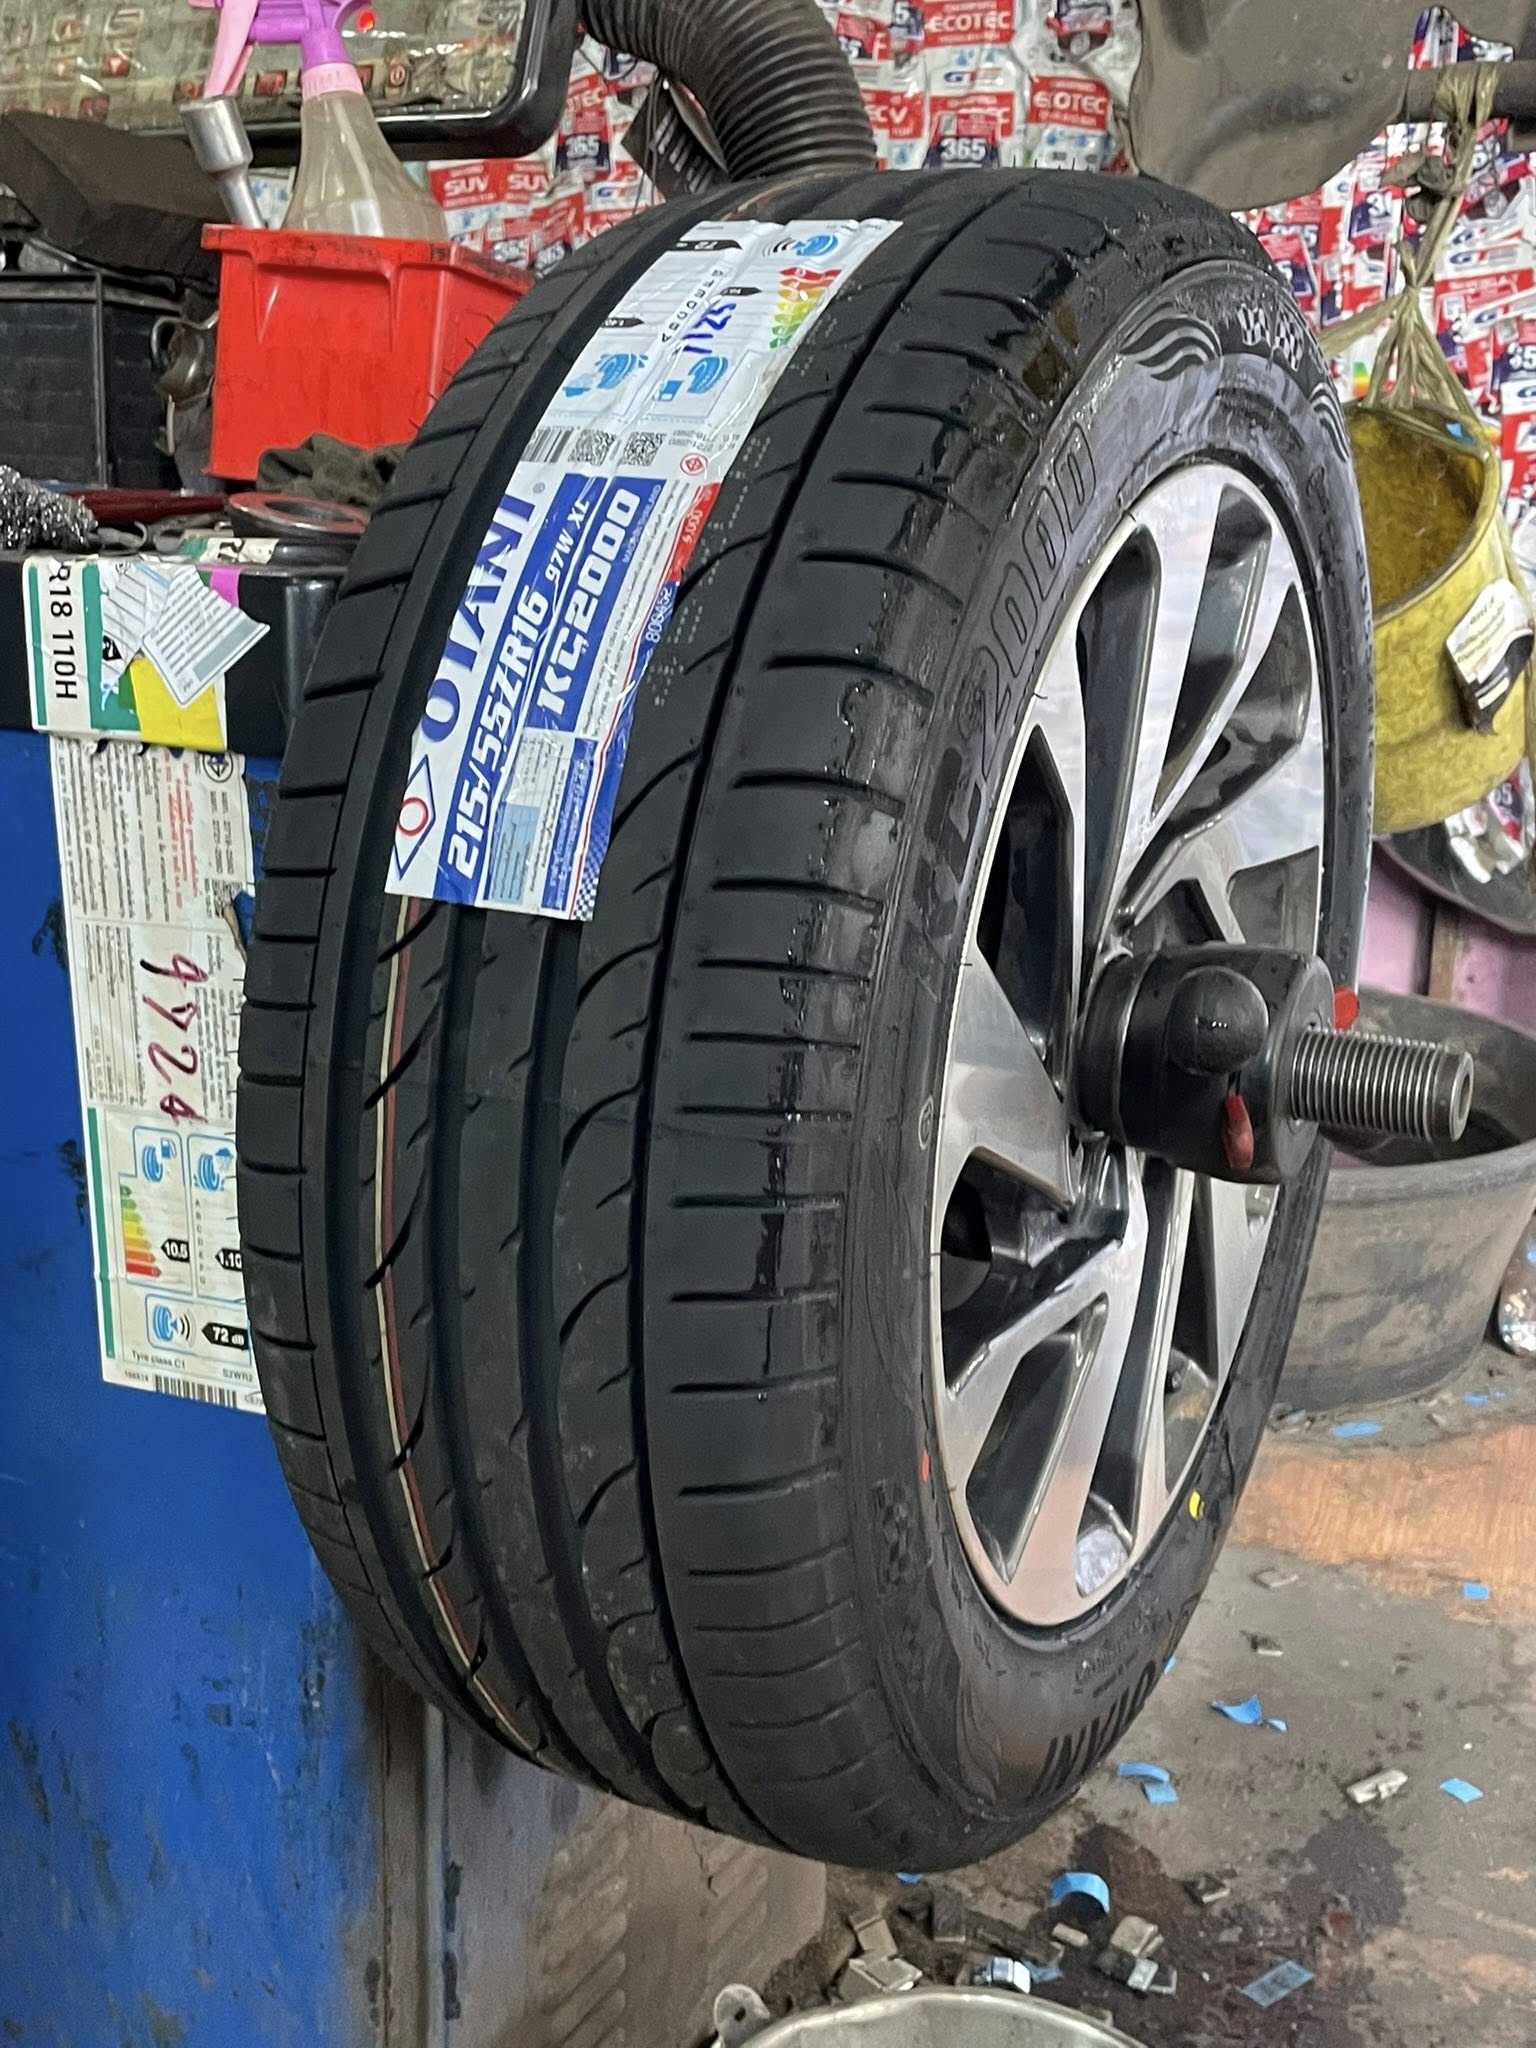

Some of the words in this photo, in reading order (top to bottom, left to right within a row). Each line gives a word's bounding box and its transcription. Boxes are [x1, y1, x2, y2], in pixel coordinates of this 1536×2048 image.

[926, 10, 1011, 33] ECOTEC
[940, 137, 987, 162] 365
[443, 174, 489, 198] SUV
[537, 488, 641, 716] KC2000
[420, 497, 535, 743] OTANI
[52, 629, 79, 700] 110H
[448, 585, 549, 880] 215/55ZR16
[545, 532, 576, 580] 97W
[567, 497, 591, 527] XL
[213, 1326, 230, 1343] 72
[132, 1350, 149, 1363] Tyre
